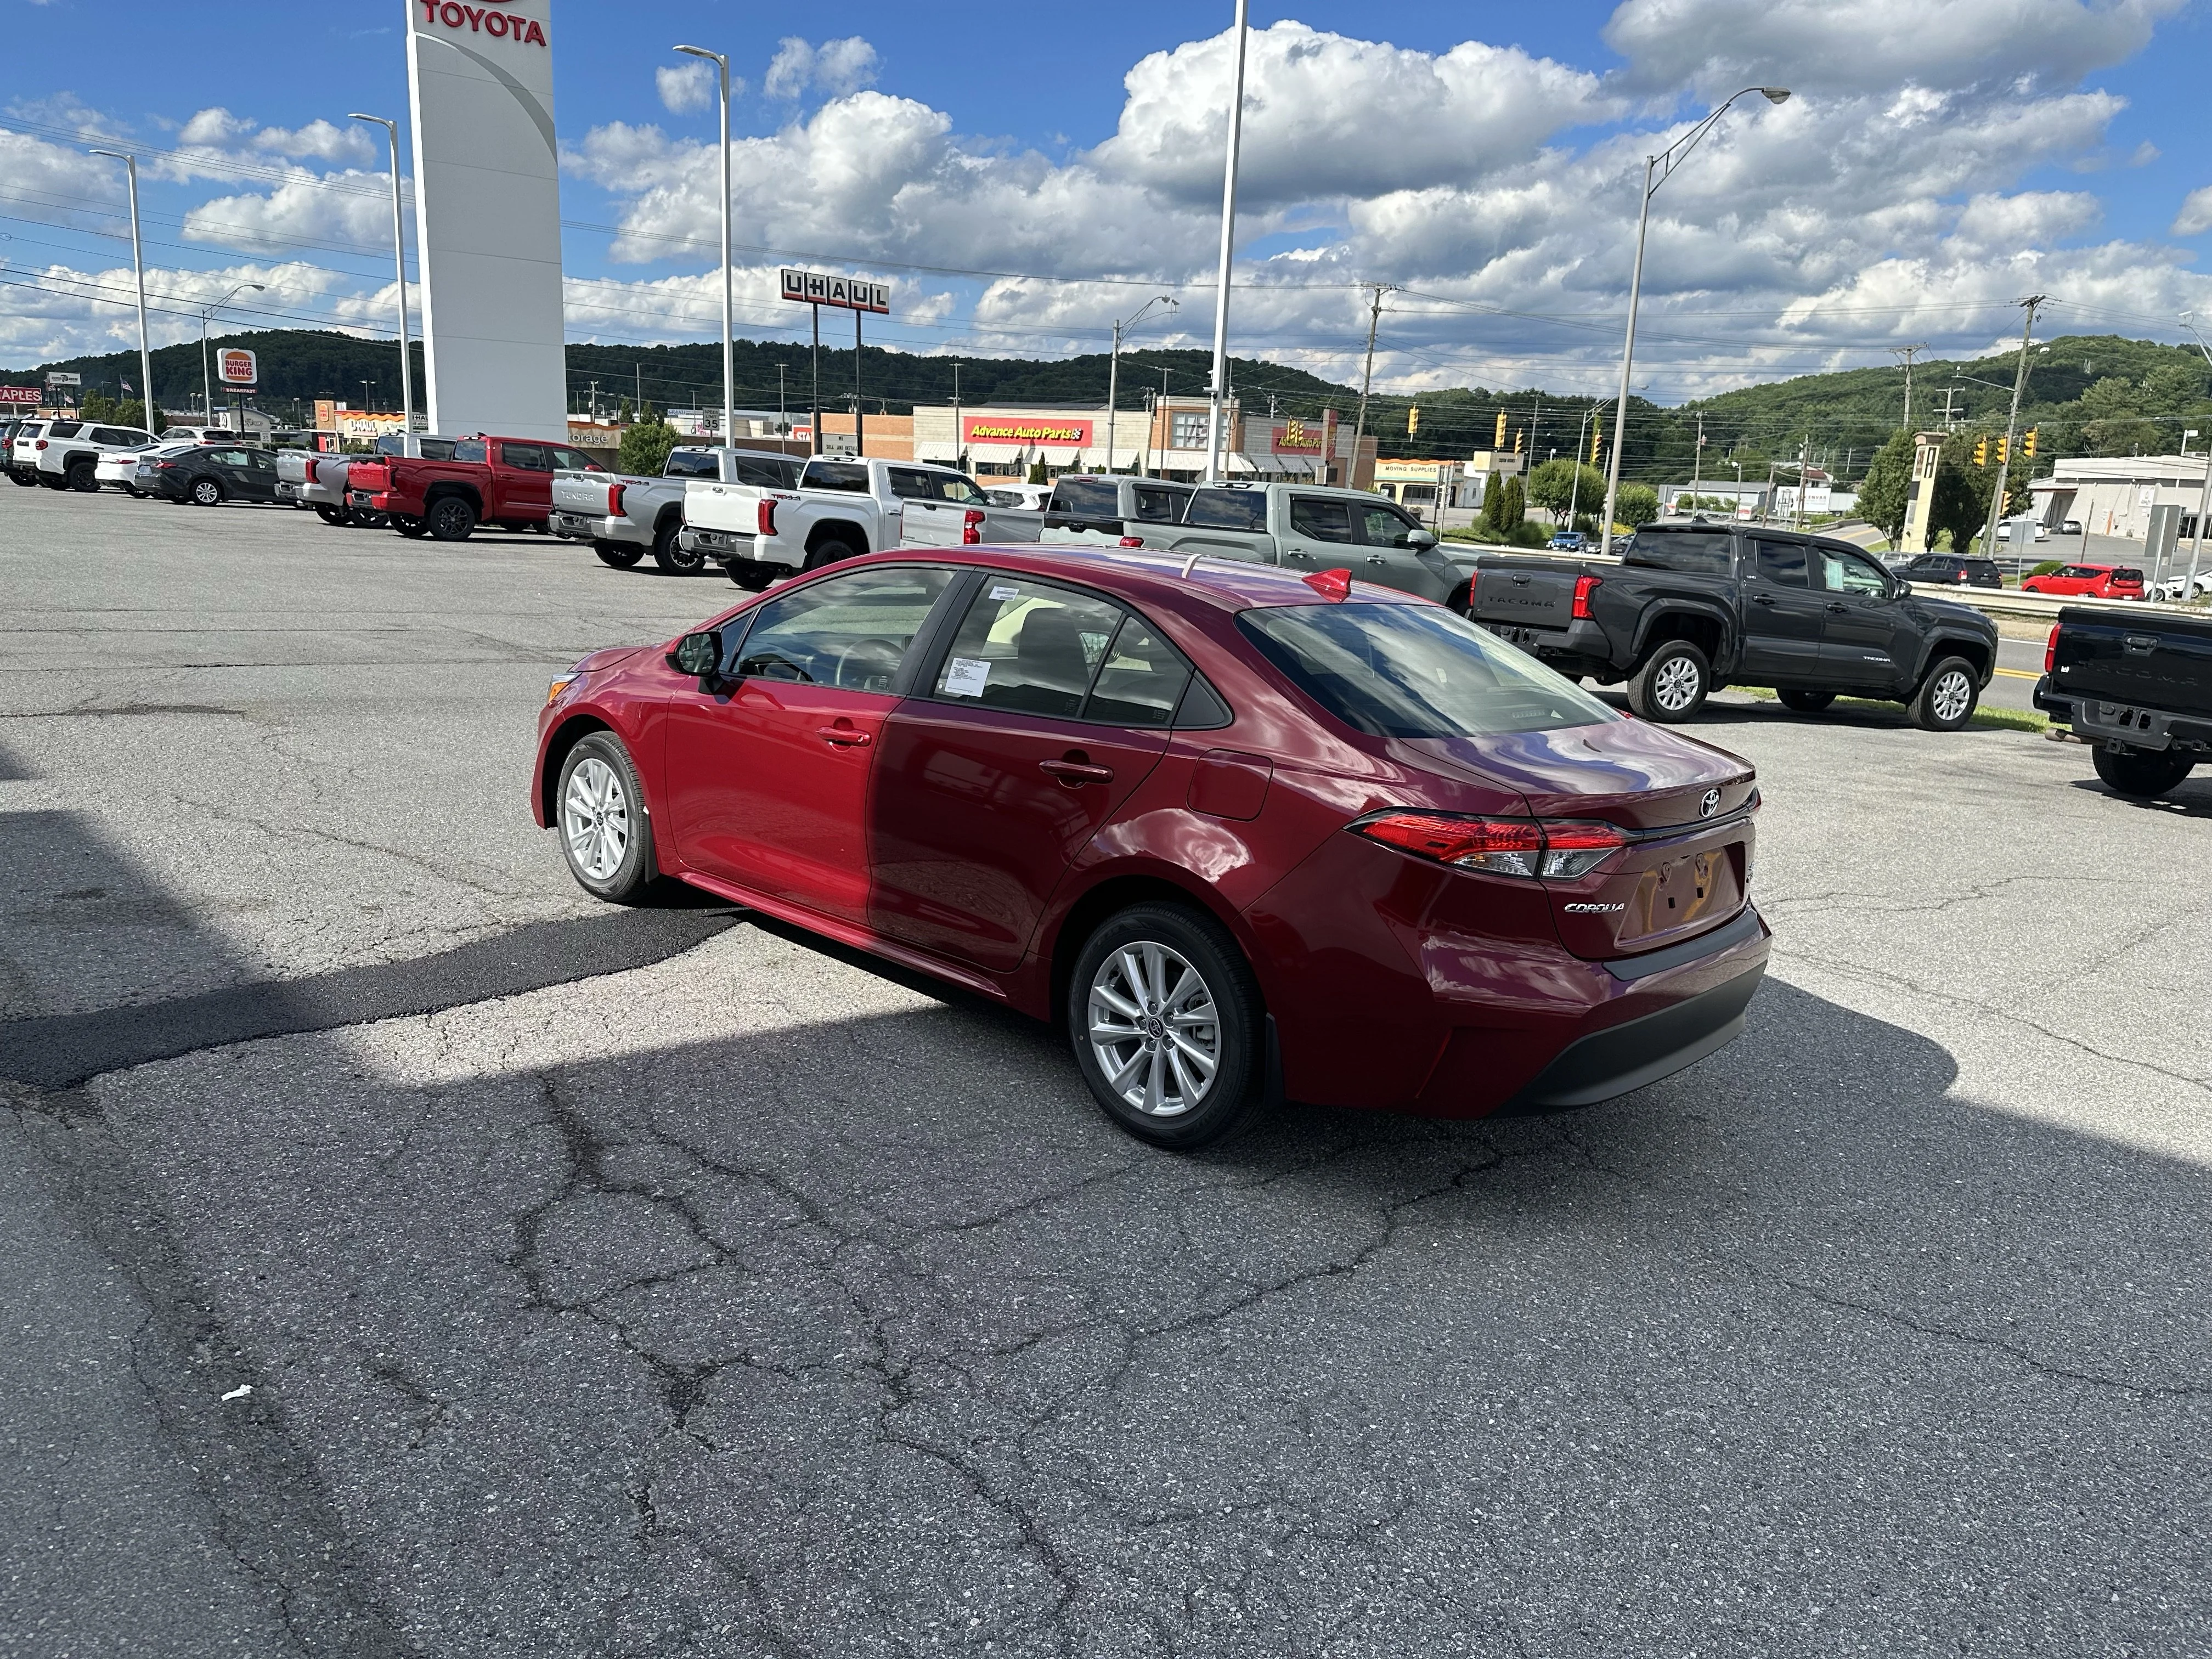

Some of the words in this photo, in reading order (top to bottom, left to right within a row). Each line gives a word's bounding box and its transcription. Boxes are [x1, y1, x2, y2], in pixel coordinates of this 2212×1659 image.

[420, 0, 546, 47] TOYOTA
[226, 366, 253, 376] KING
[705, 419, 718, 428] 35
[568, 432, 608, 445] torage
[971, 425, 1014, 438] Advance
[1014, 426, 1042, 439] Auto
[1042, 427, 1072, 440] Parts
[1312, 438, 1322, 448] Par
[1488, 596, 1554, 608] TACOMA
[1564, 902, 1625, 914] COROLLA
